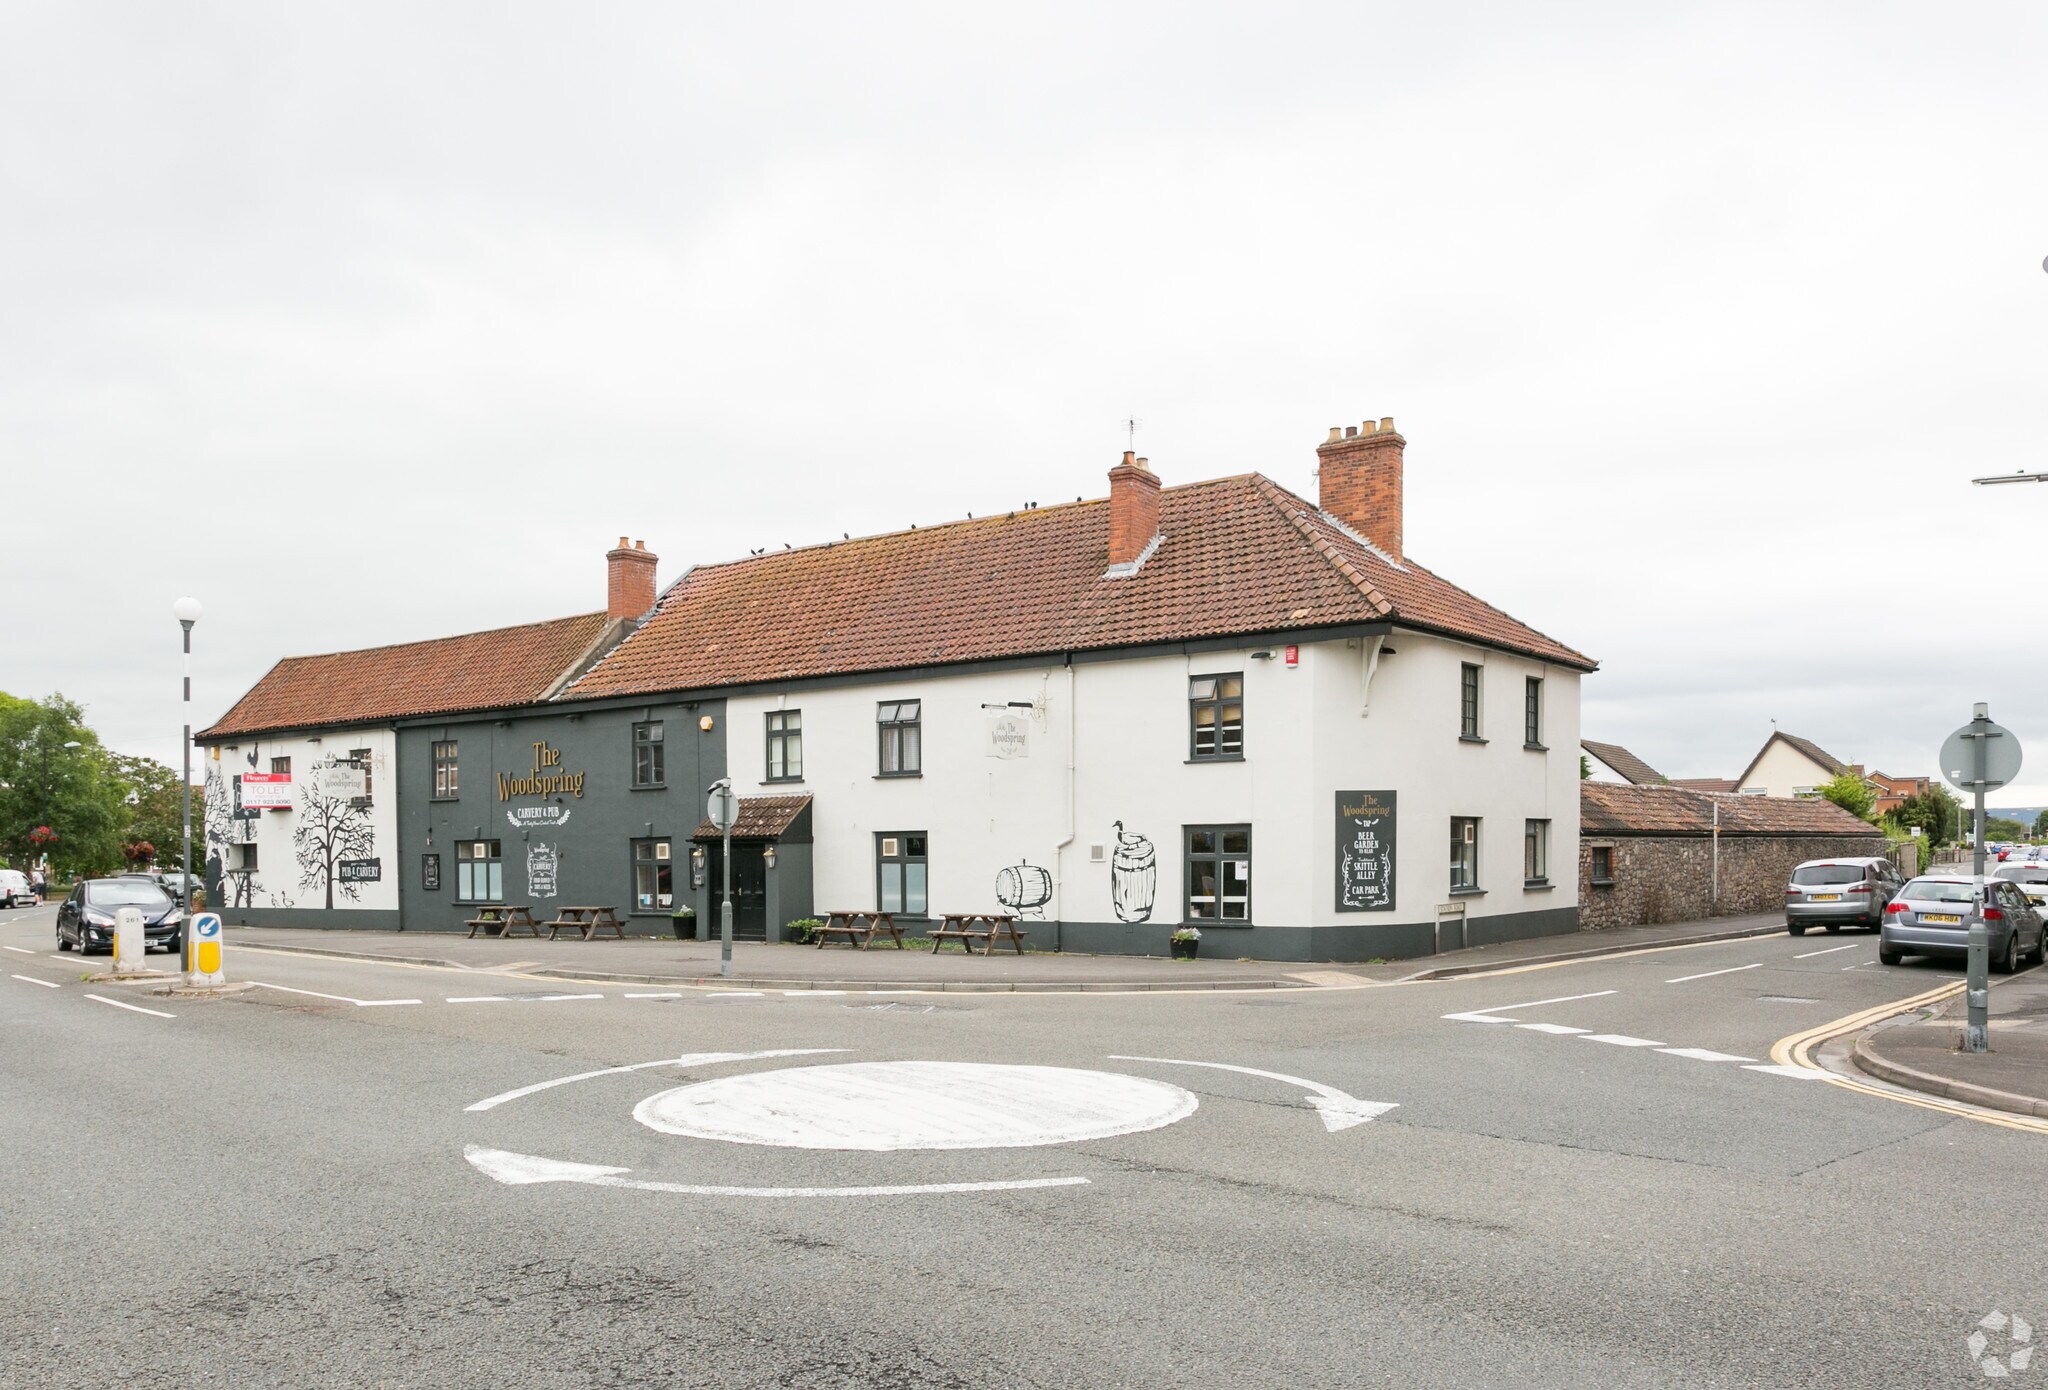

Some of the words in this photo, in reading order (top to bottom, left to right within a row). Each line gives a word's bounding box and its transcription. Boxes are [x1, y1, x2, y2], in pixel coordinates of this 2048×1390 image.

[992, 731, 1026, 746] Woodspring
[533, 741, 560, 772] The
[325, 779, 362, 789] Woodspring
[497, 767, 585, 801] Woodspring
[252, 786, 265, 794] TO
[268, 786, 286, 794] LET
[1363, 794, 1378, 806] The
[517, 807, 542, 819] CARVERY
[543, 808, 547, 817] &
[547, 806, 559, 817] PUB
[1343, 805, 1390, 817] Woodspring
[1358, 832, 1375, 840] BEER
[1354, 840, 1379, 849] GARDEN
[341, 866, 351, 877] PUB
[356, 866, 379, 877] CARVERY
[1354, 862, 1378, 871] SKITTLE
[1356, 871, 1376, 880] ALLEY
[1352, 886, 1365, 895] CAR
[1365, 885, 1380, 894] PARK
